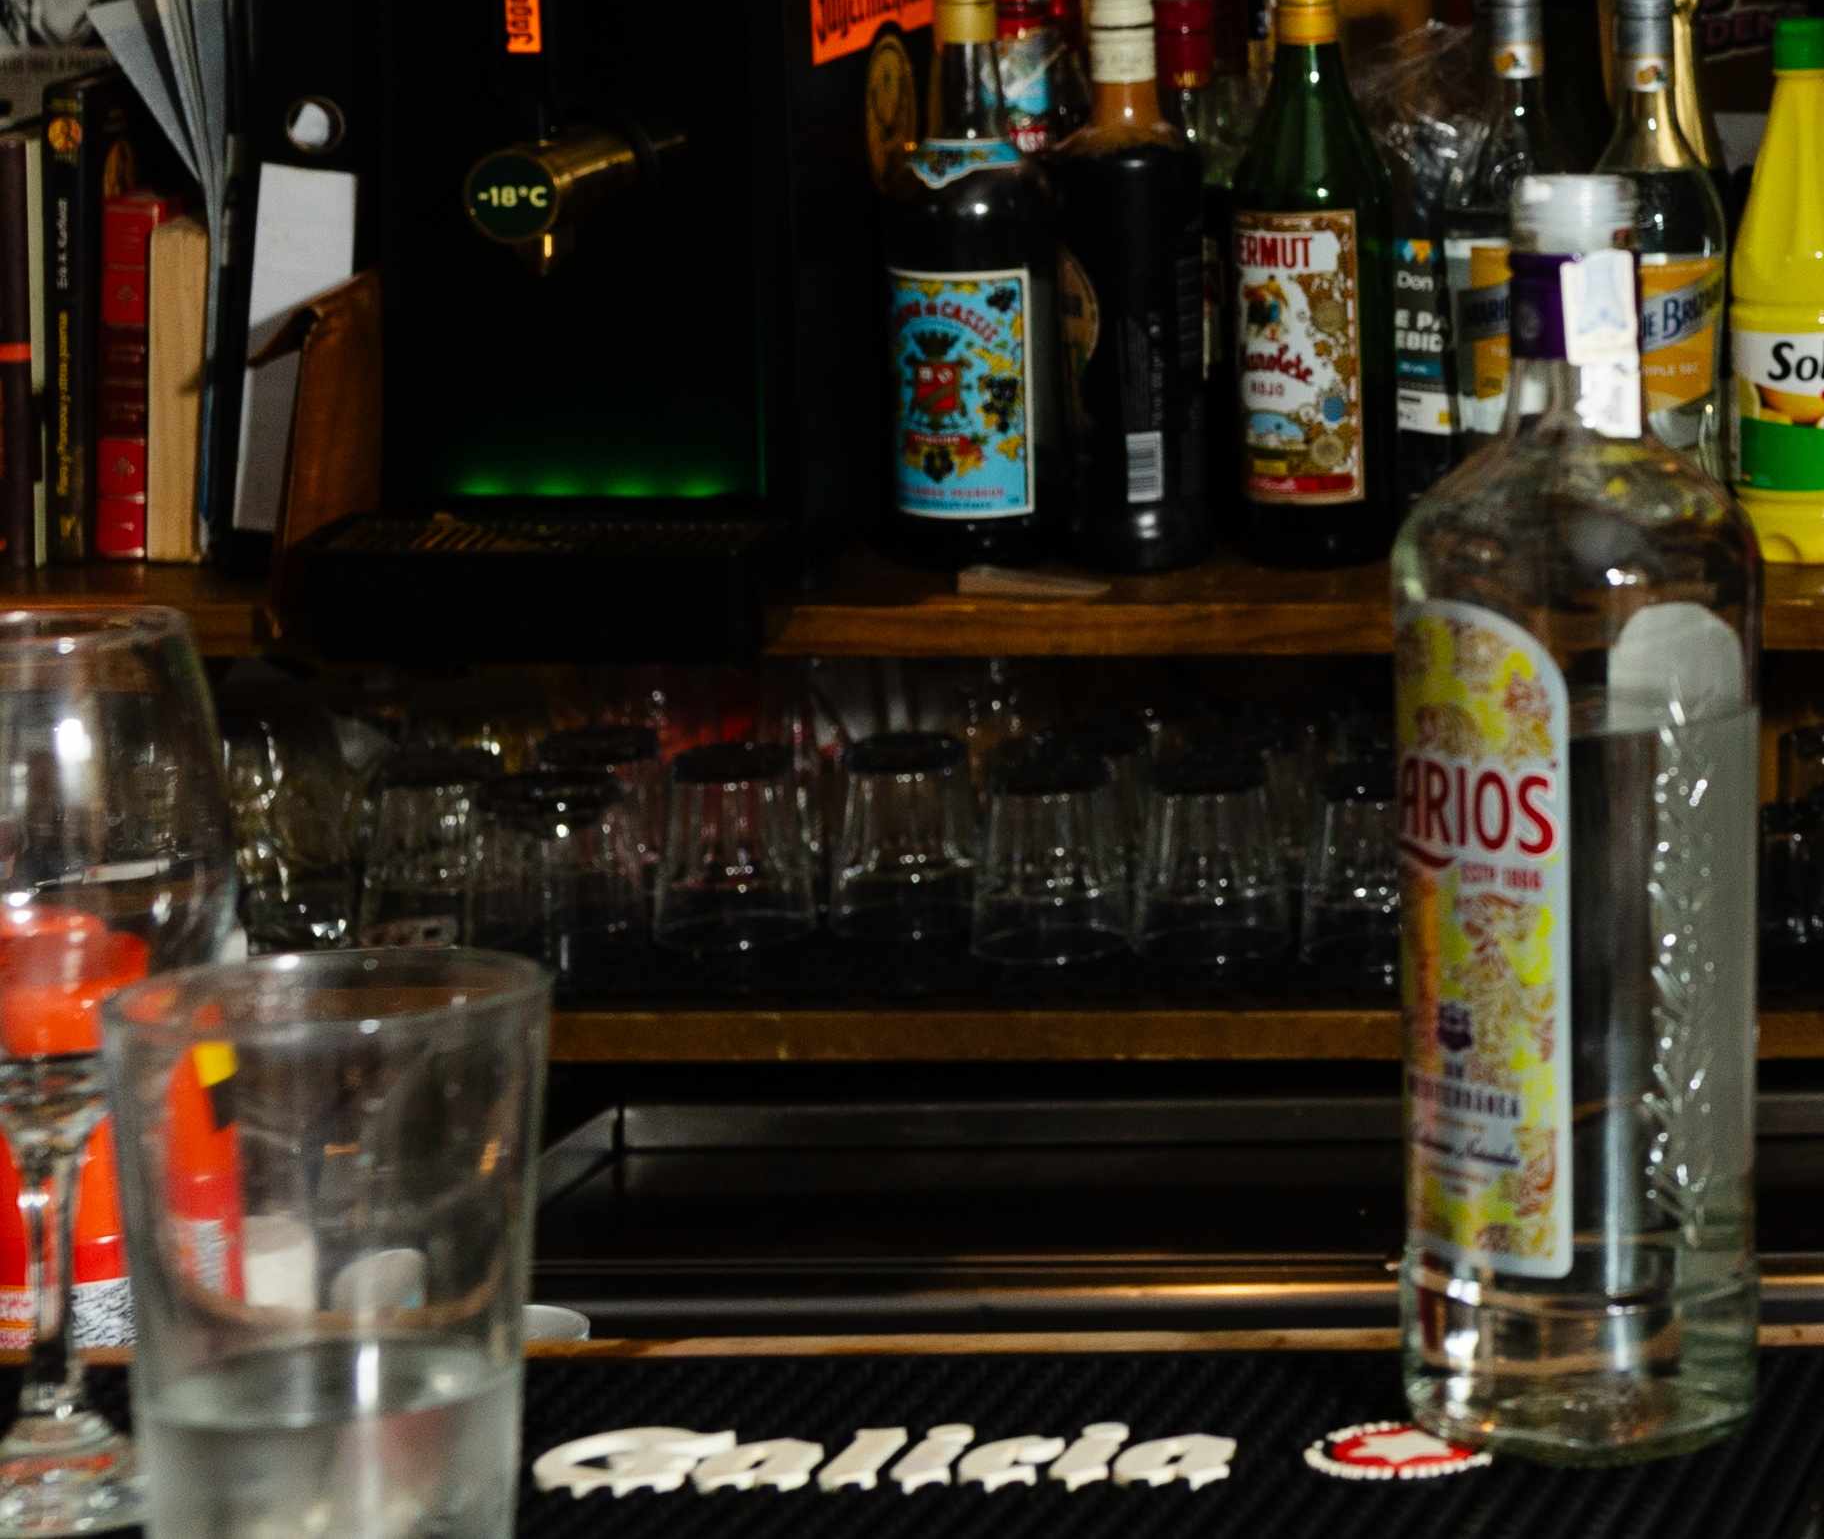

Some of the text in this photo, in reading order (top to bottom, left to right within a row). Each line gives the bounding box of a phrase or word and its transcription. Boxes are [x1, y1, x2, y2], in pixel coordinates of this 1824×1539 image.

[477, 185, 549, 209] -18°C
[1397, 271, 1434, 292] Don
[531, 1421, 1237, 1496] Galicia
